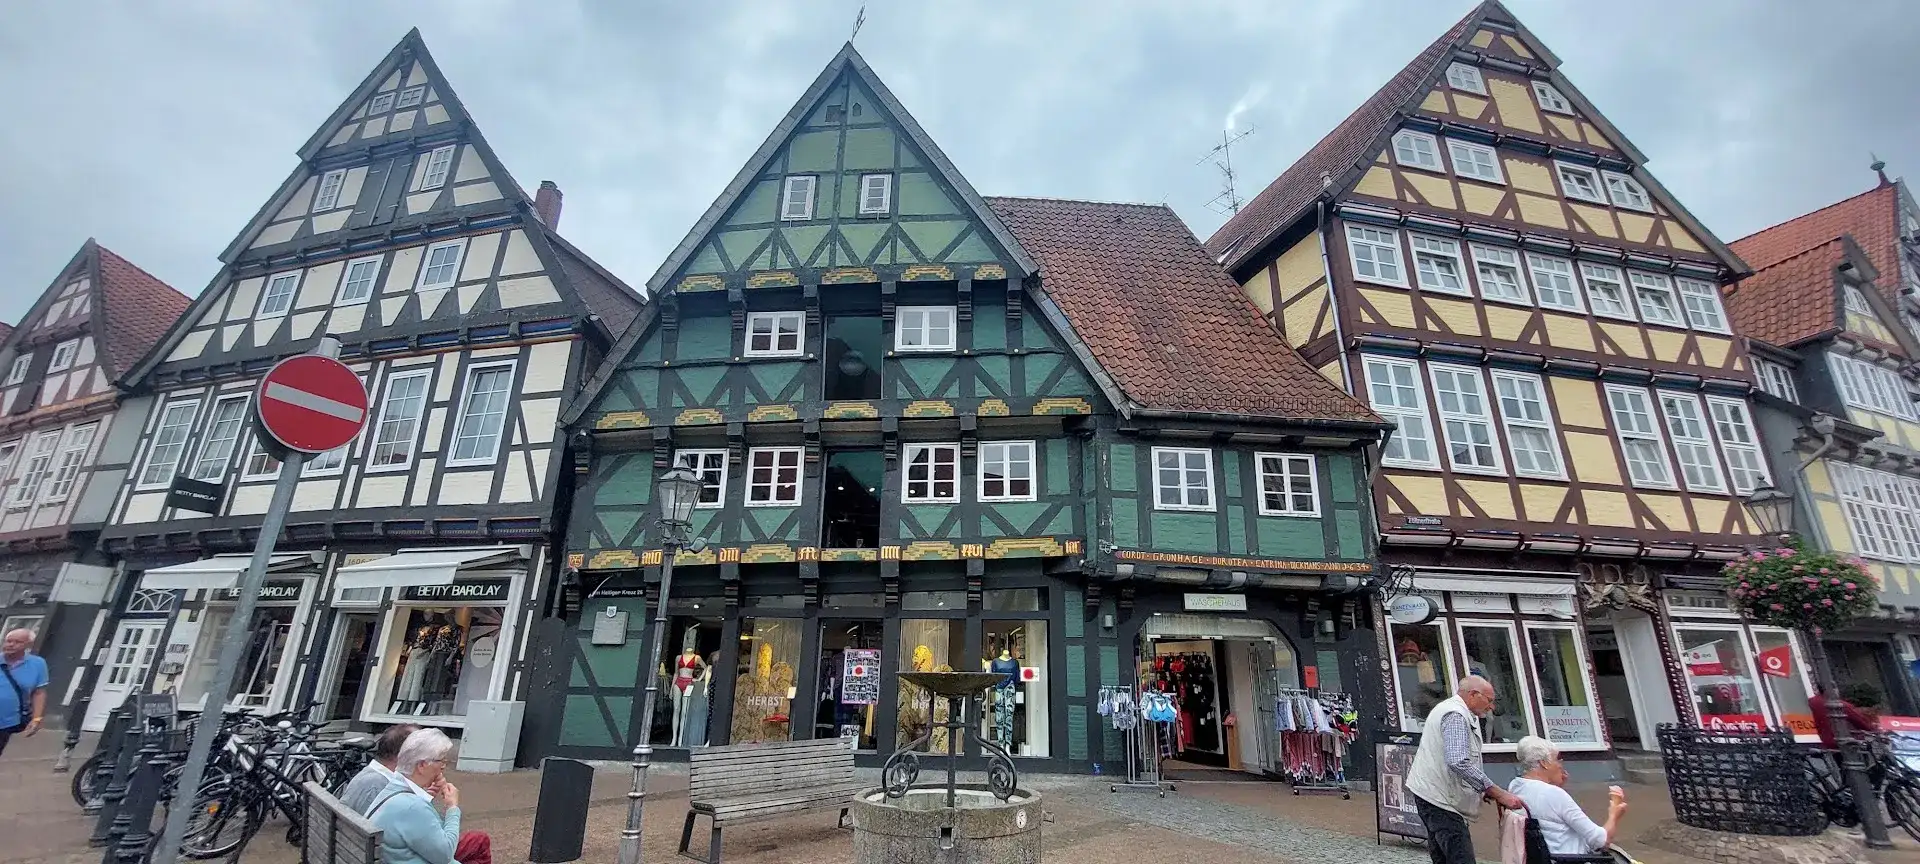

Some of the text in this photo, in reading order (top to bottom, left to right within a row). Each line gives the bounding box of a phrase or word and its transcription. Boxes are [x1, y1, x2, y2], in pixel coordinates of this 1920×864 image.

[175, 489, 218, 502] BETTY BARCLAY
[258, 586, 298, 597] BARCLAY
[417, 584, 502, 597] BETTY BARCLAY
[747, 695, 785, 706] HERBST
[1561, 708, 1572, 716] ZU
[1546, 718, 1590, 726] VERMIETEN
